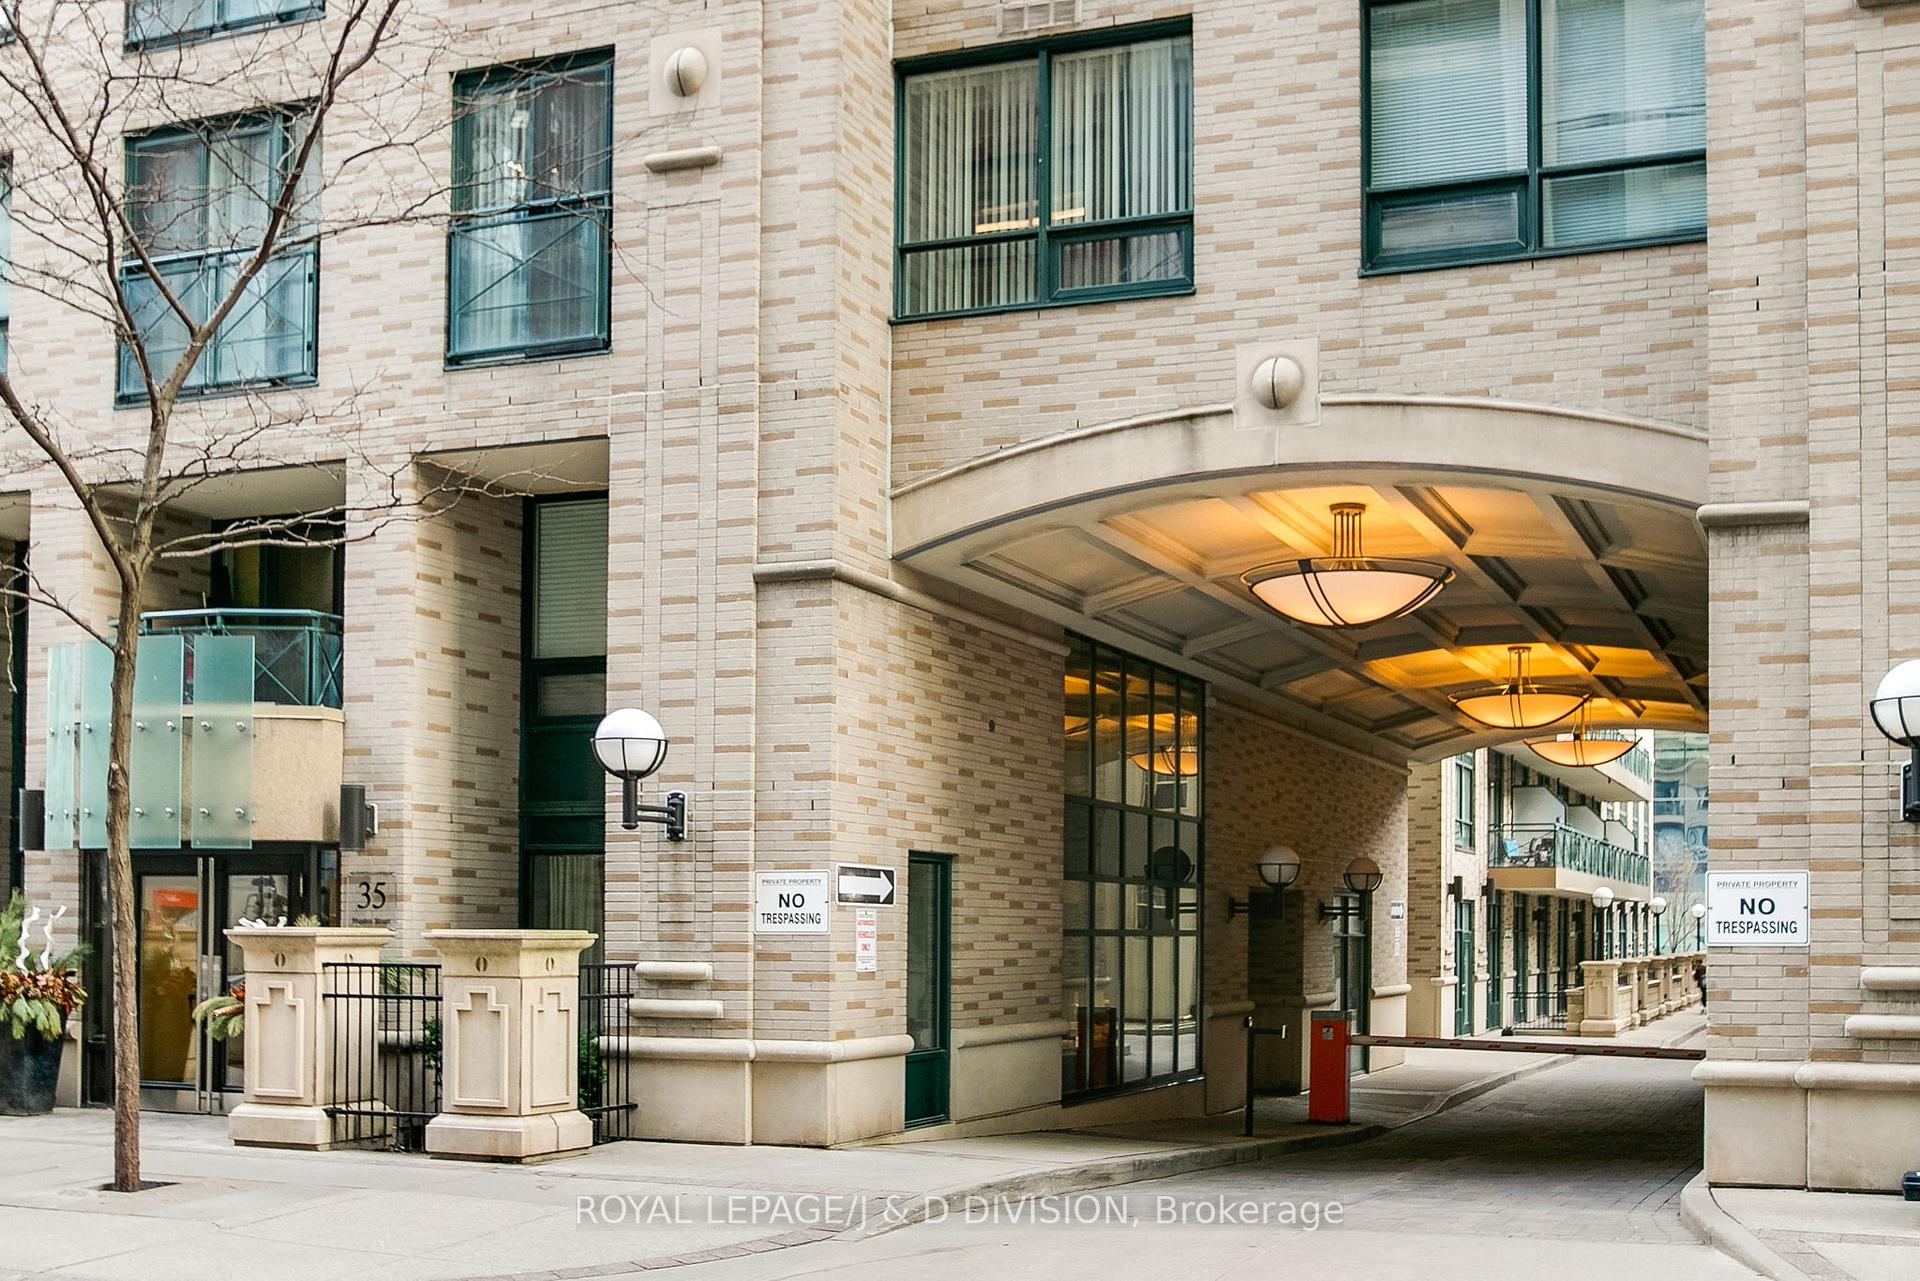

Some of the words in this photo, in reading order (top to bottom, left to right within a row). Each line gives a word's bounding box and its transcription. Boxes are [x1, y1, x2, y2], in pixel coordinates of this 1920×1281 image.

[357, 881, 386, 909] 35
[779, 893, 805, 908] NO
[1740, 898, 1776, 915] NO
[761, 913, 821, 924] TRESPASSING
[1716, 921, 1798, 934] TRESPASSING
